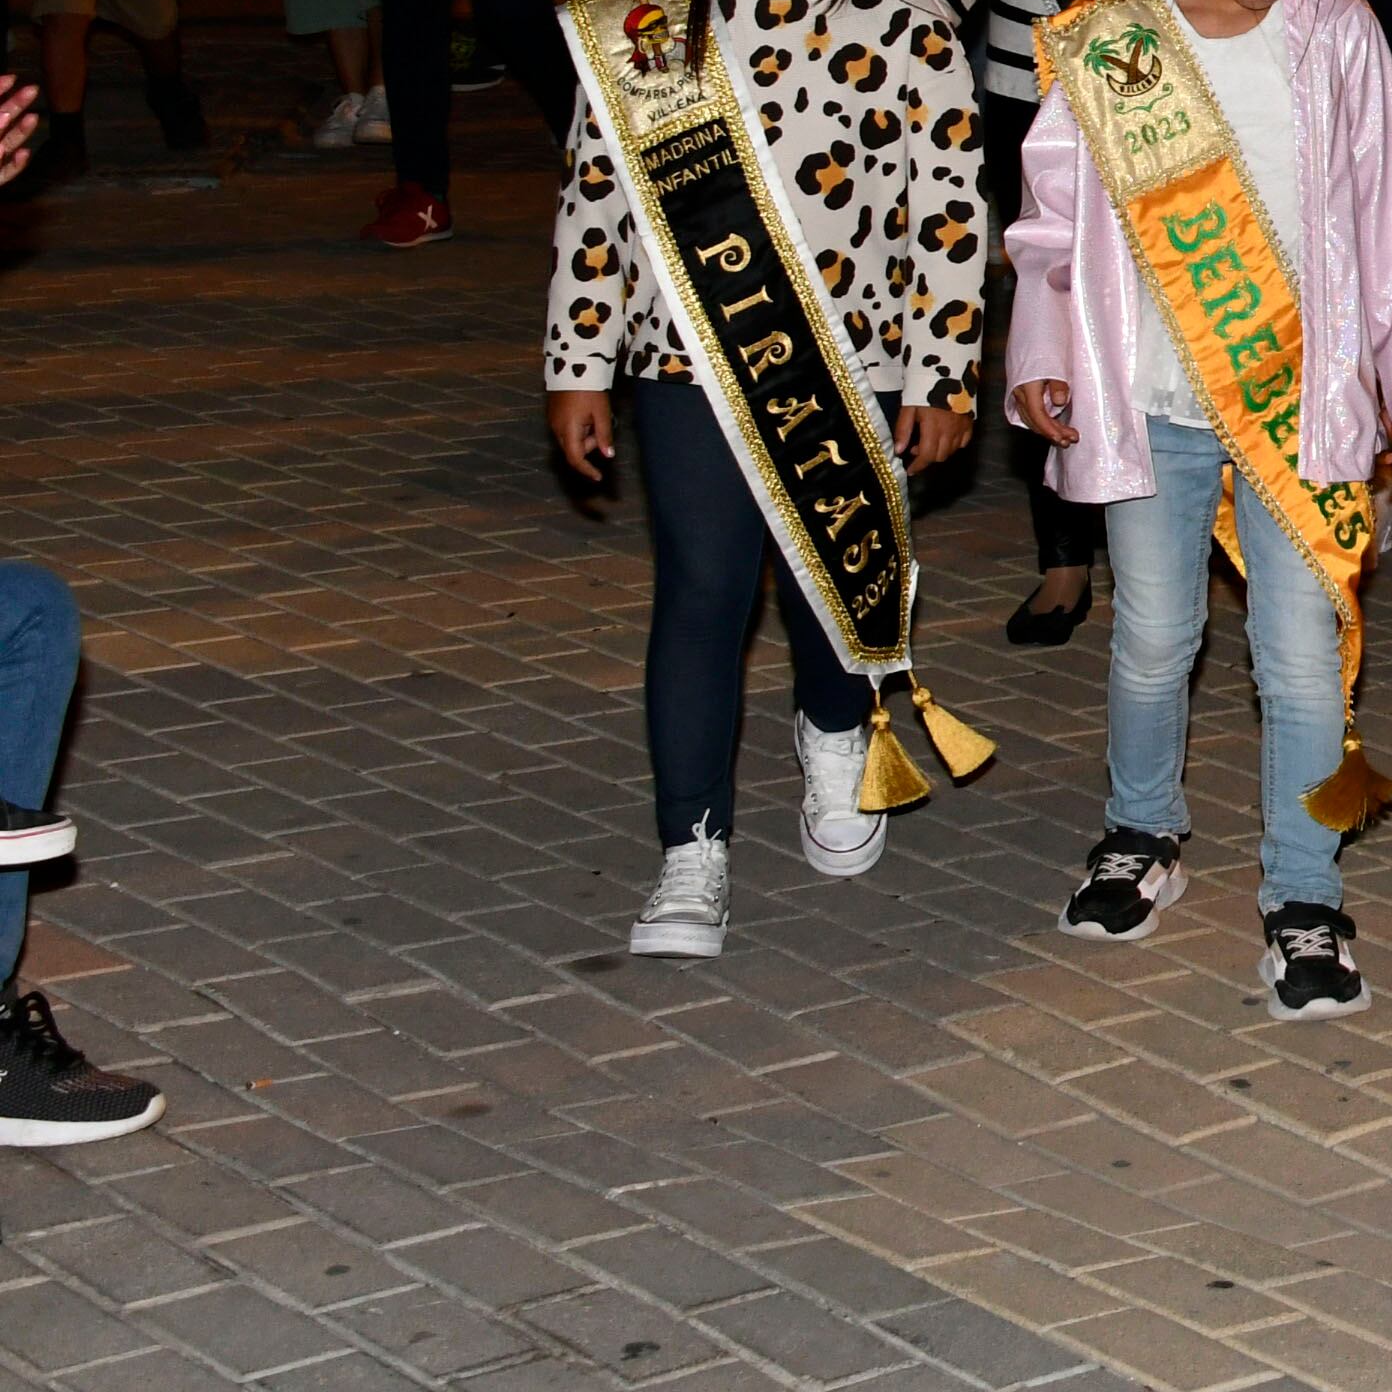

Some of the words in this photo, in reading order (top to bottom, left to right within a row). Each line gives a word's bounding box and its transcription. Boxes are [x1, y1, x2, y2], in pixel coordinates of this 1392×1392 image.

[616, 76, 678, 100] COMPARSA
[647, 92, 706, 122] VILLENA
[643, 124, 728, 171] MADRINA
[1124, 111, 1191, 154] 2023
[655, 148, 740, 196] NFANTIL
[1159, 198, 1370, 550] BEREBEES
[696, 228, 883, 574] PIRATAS
